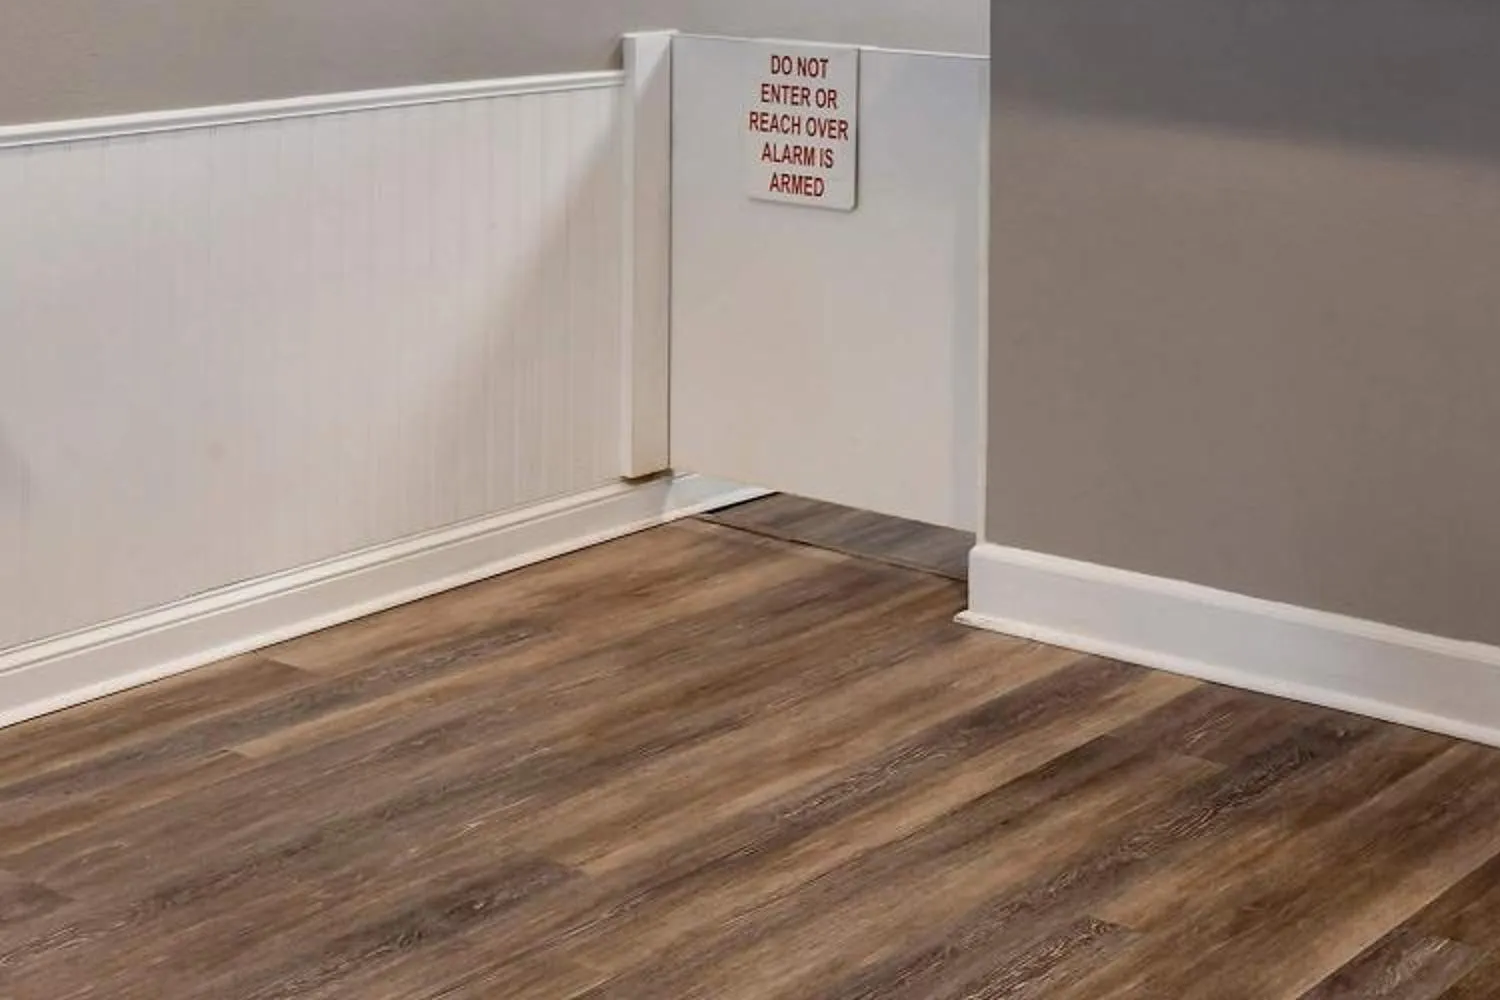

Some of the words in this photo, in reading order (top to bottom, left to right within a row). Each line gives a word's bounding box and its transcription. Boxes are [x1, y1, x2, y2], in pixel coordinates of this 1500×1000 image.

[771, 54, 793, 75] DO
[797, 57, 829, 79] NOT
[761, 83, 811, 107] ENTER
[815, 88, 838, 110] OR
[749, 111, 801, 135] REACH
[805, 117, 849, 141] OVER
[761, 142, 815, 167] ALARM
[820, 149, 834, 169] IS
[769, 172, 825, 197] ARMED
